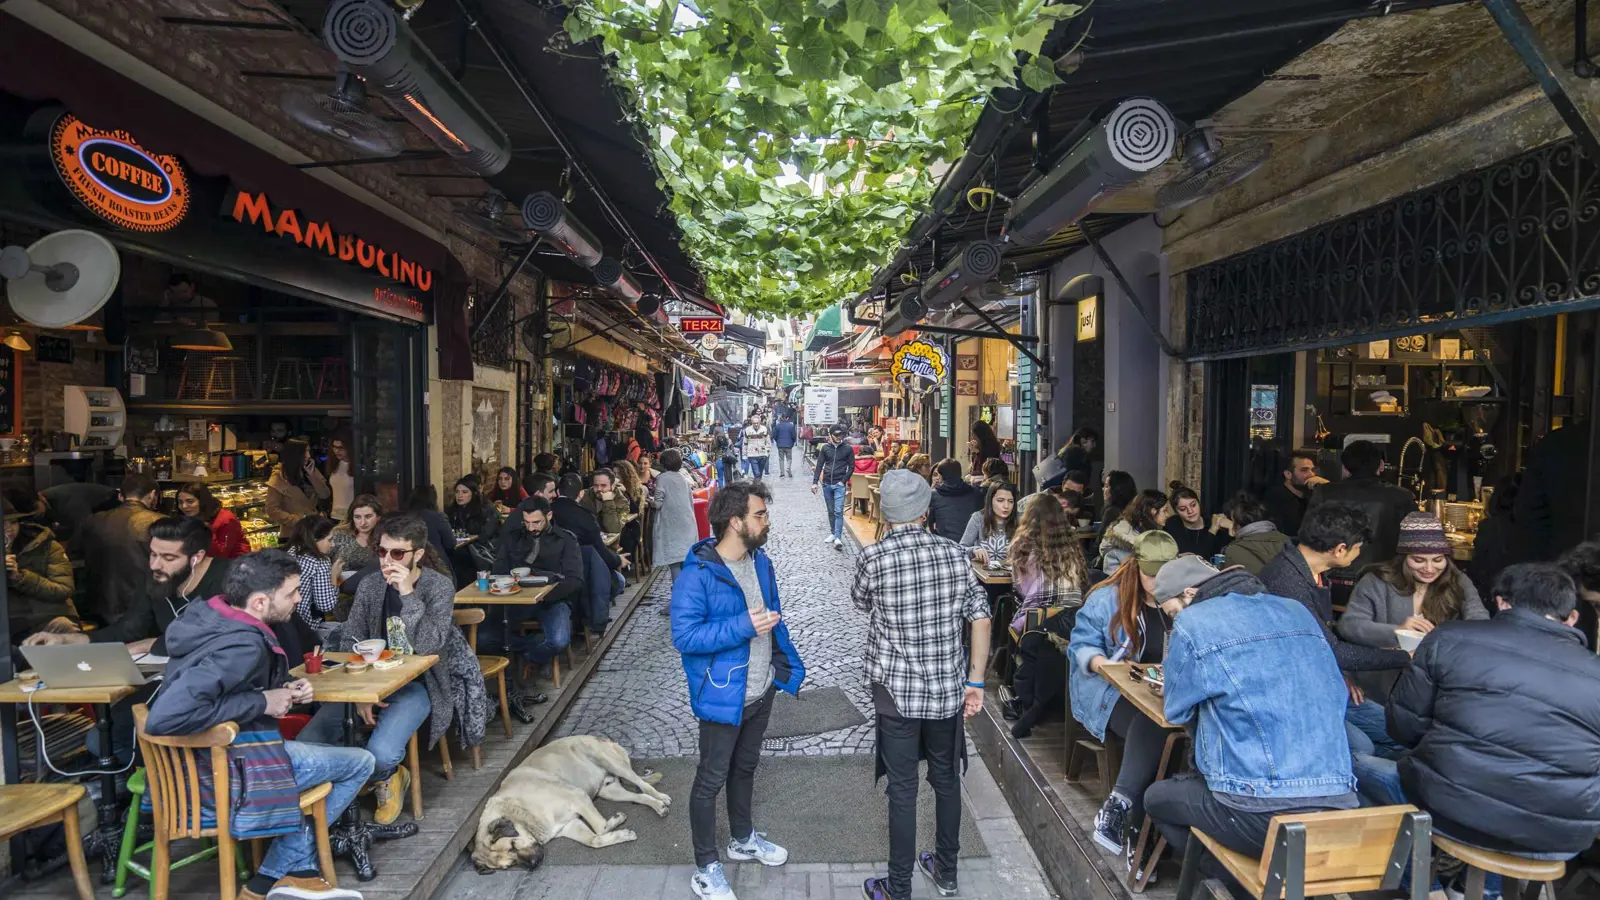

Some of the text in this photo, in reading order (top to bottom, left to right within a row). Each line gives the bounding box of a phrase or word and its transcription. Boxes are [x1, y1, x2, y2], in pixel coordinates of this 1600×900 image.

[72, 167, 178, 221] FRESH ROASTED BEANS
[91, 151, 164, 194] COFFEE
[901, 358, 937, 376] Waffles
